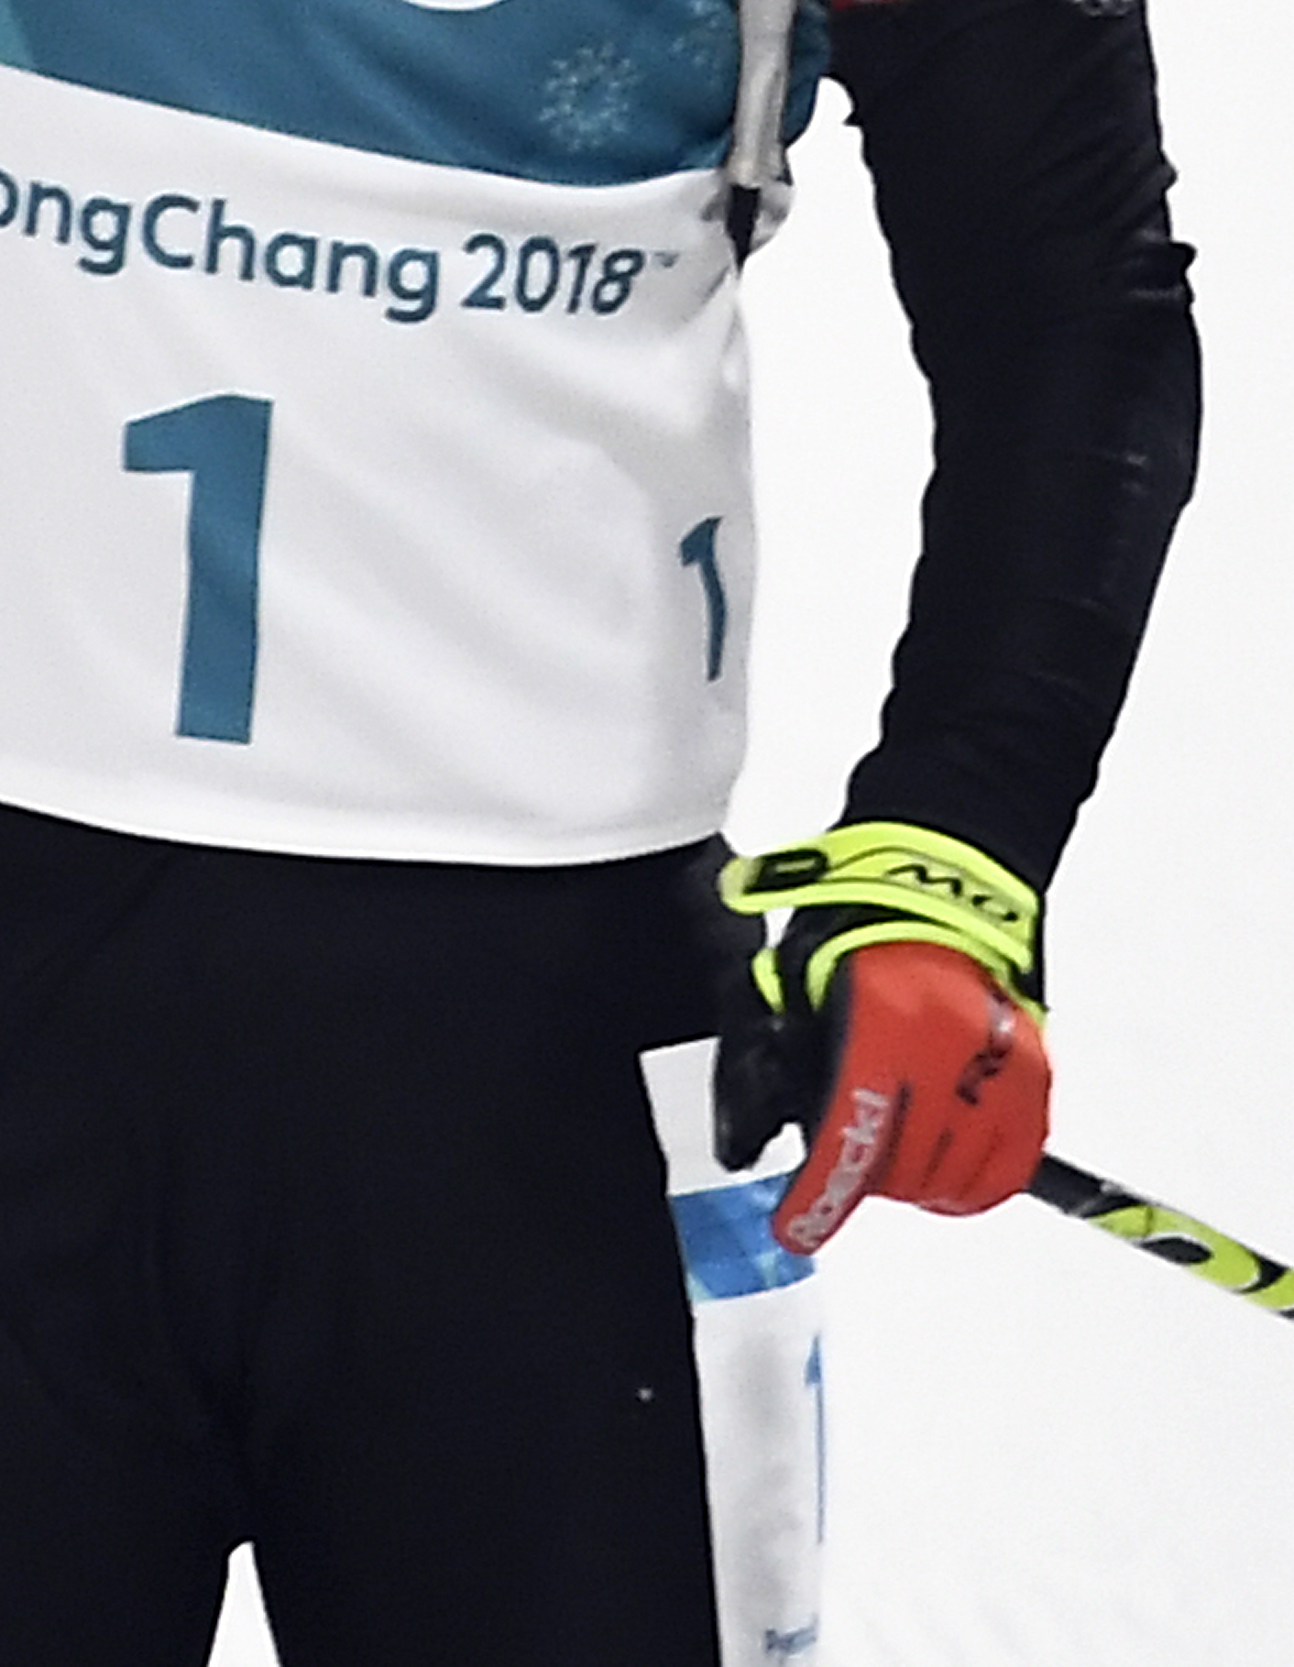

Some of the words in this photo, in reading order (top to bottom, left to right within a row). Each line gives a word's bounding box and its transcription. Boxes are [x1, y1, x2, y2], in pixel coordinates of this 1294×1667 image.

[460, 233, 646, 316] 2018
[124, 394, 273, 745] 1
[678, 515, 729, 683] 1
